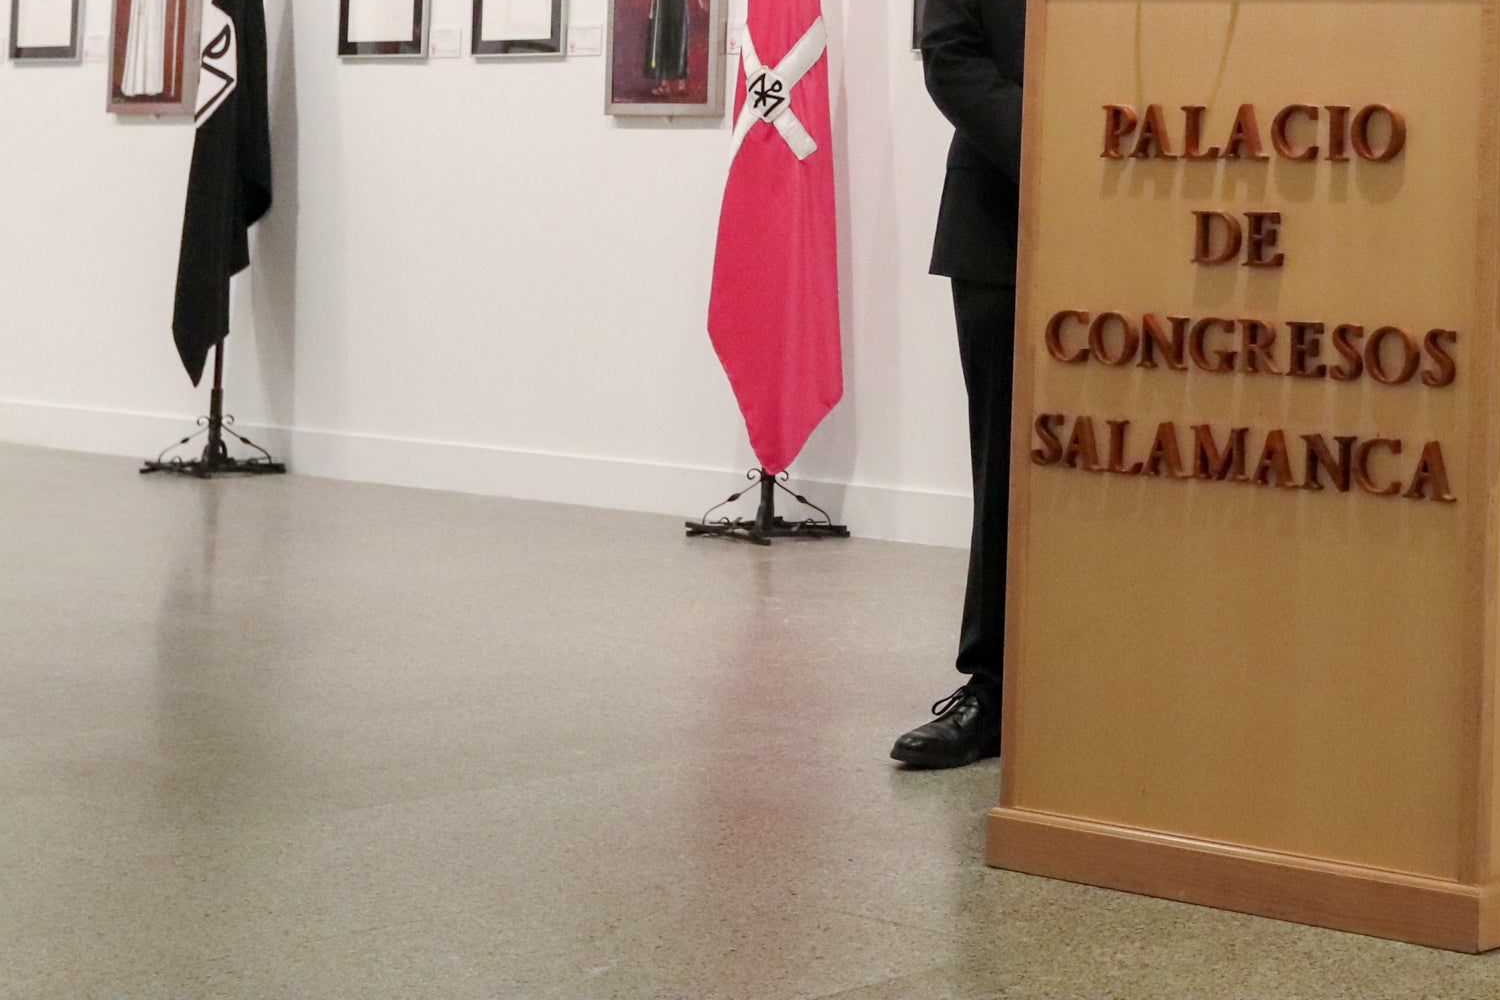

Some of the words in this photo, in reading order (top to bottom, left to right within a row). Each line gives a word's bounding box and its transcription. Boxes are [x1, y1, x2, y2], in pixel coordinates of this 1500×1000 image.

[1100, 103, 1407, 162] PALACIO
[1190, 210, 1285, 267] DE
[1045, 310, 1458, 387] CONGRESOS
[1030, 413, 1458, 502] SALAMANCA
